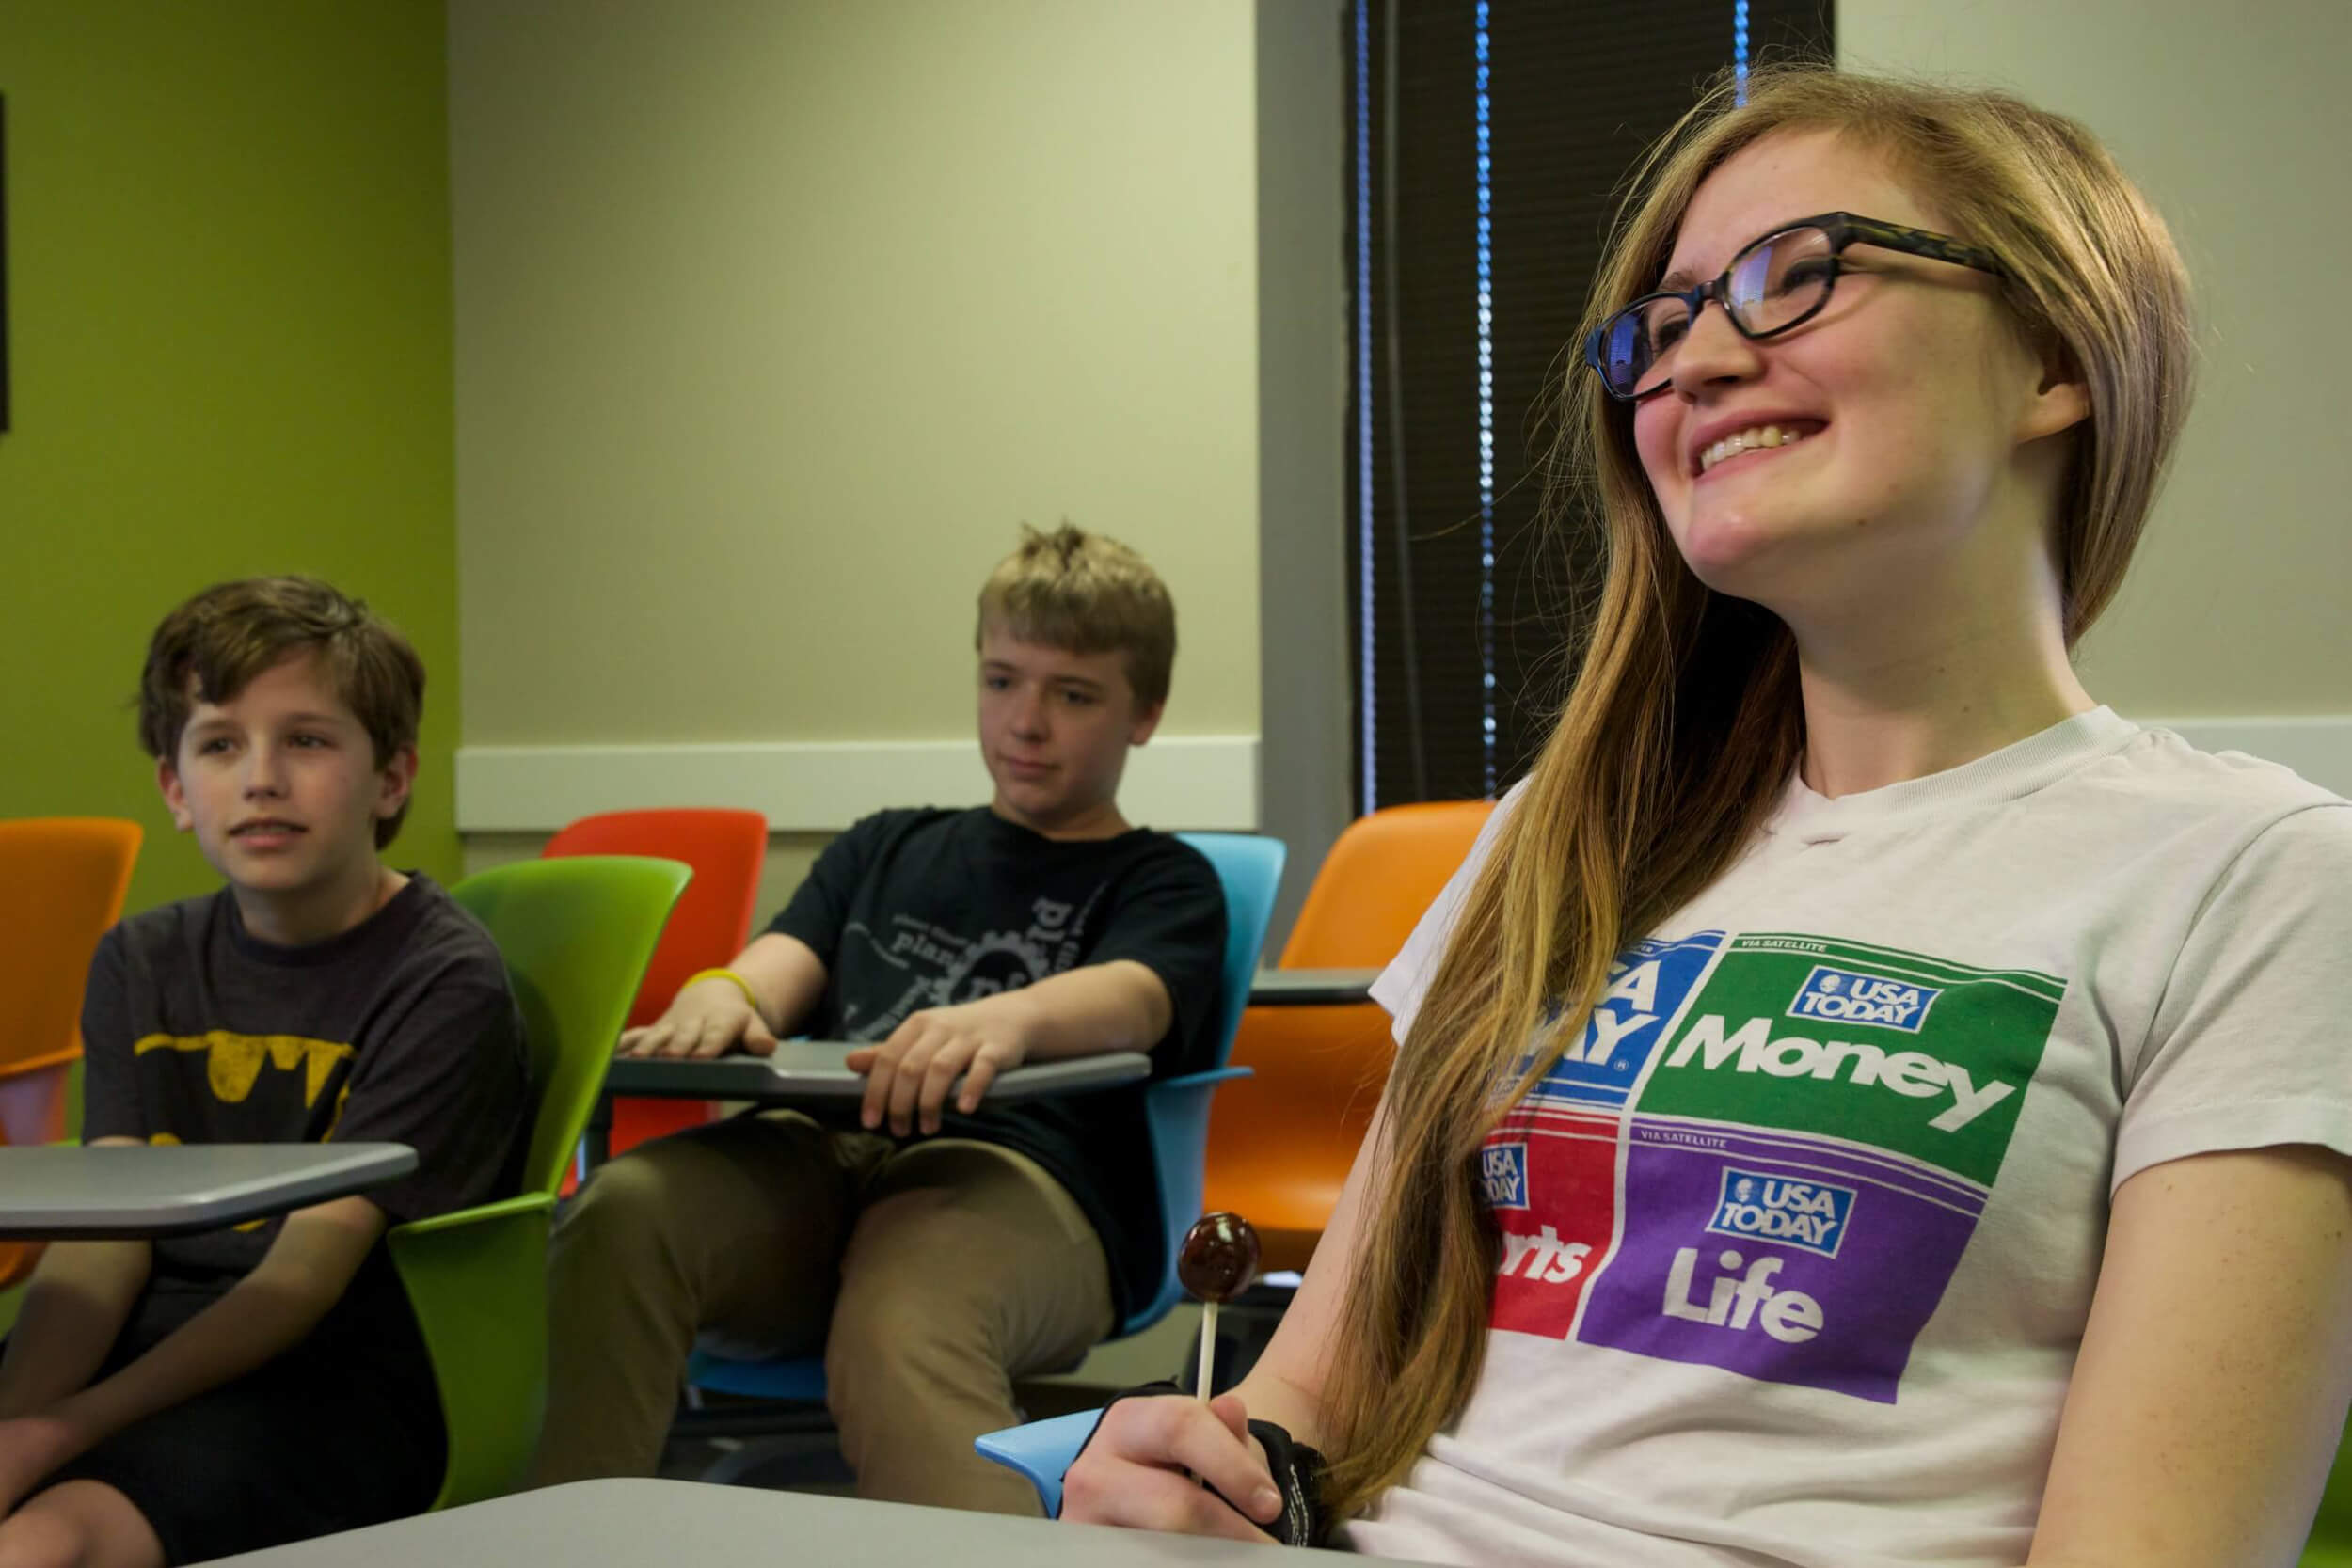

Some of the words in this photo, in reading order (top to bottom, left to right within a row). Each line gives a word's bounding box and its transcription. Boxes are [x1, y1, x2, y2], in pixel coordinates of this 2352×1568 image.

[1742, 940, 1760, 949] VIA
[1761, 941, 1827, 954] SATELLITE
[1804, 991, 1920, 1025] TODAY
[1850, 978, 1919, 1006] USA
[1665, 1014, 2017, 1133] Money
[1640, 1129, 1661, 1142] VIA
[1662, 1131, 1728, 1149] SATELLITE
[1762, 1180, 1836, 1219] USA
[1721, 1201, 1837, 1246] TODAY
[1499, 1224, 1593, 1285] rts
[1662, 1247, 1825, 1344] Life
